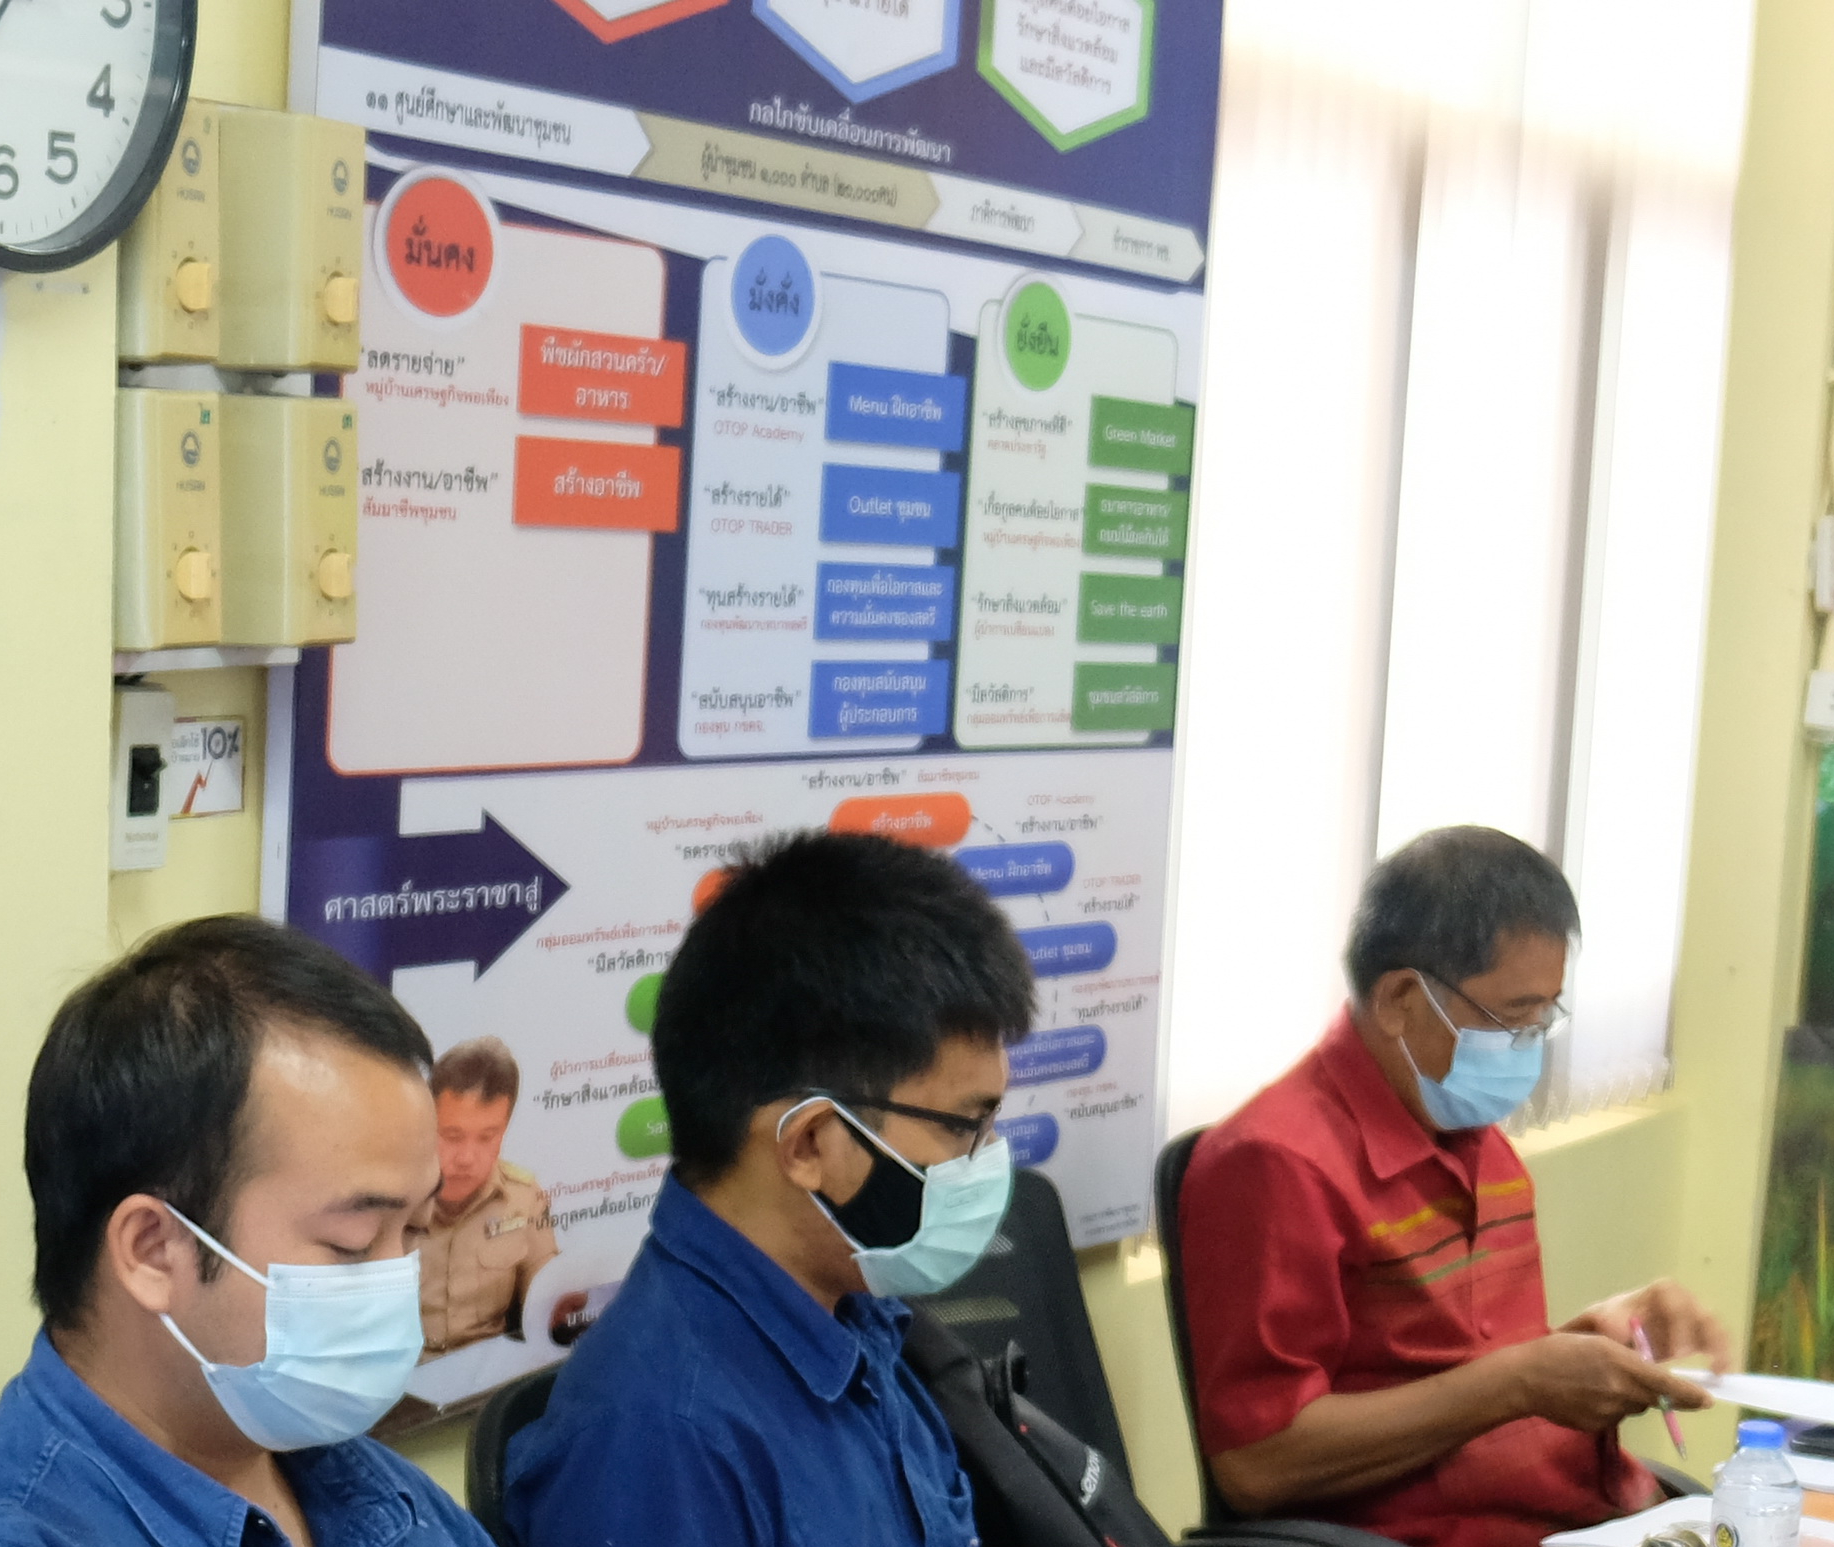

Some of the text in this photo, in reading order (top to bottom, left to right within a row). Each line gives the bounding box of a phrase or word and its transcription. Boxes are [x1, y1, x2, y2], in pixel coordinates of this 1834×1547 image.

[87, 64, 115, 117] 4
[45, 130, 78, 184] 5
[404, 214, 476, 272] มั่นคง
[749, 267, 800, 316] มั่งคั่ง
[540, 336, 666, 377] พืชผักสวนครัว/
[575, 388, 629, 412] อาหาร
[850, 396, 887, 416] Menu
[1105, 425, 1176, 449] Green Market
[554, 469, 641, 499] สร้างอาชีพ
[849, 496, 892, 516] Outlet
[750, 519, 792, 536] TRADER
[1091, 600, 1168, 619] Save the earth
[324, 874, 542, 922] ศาสตร์พระราชาสู่
